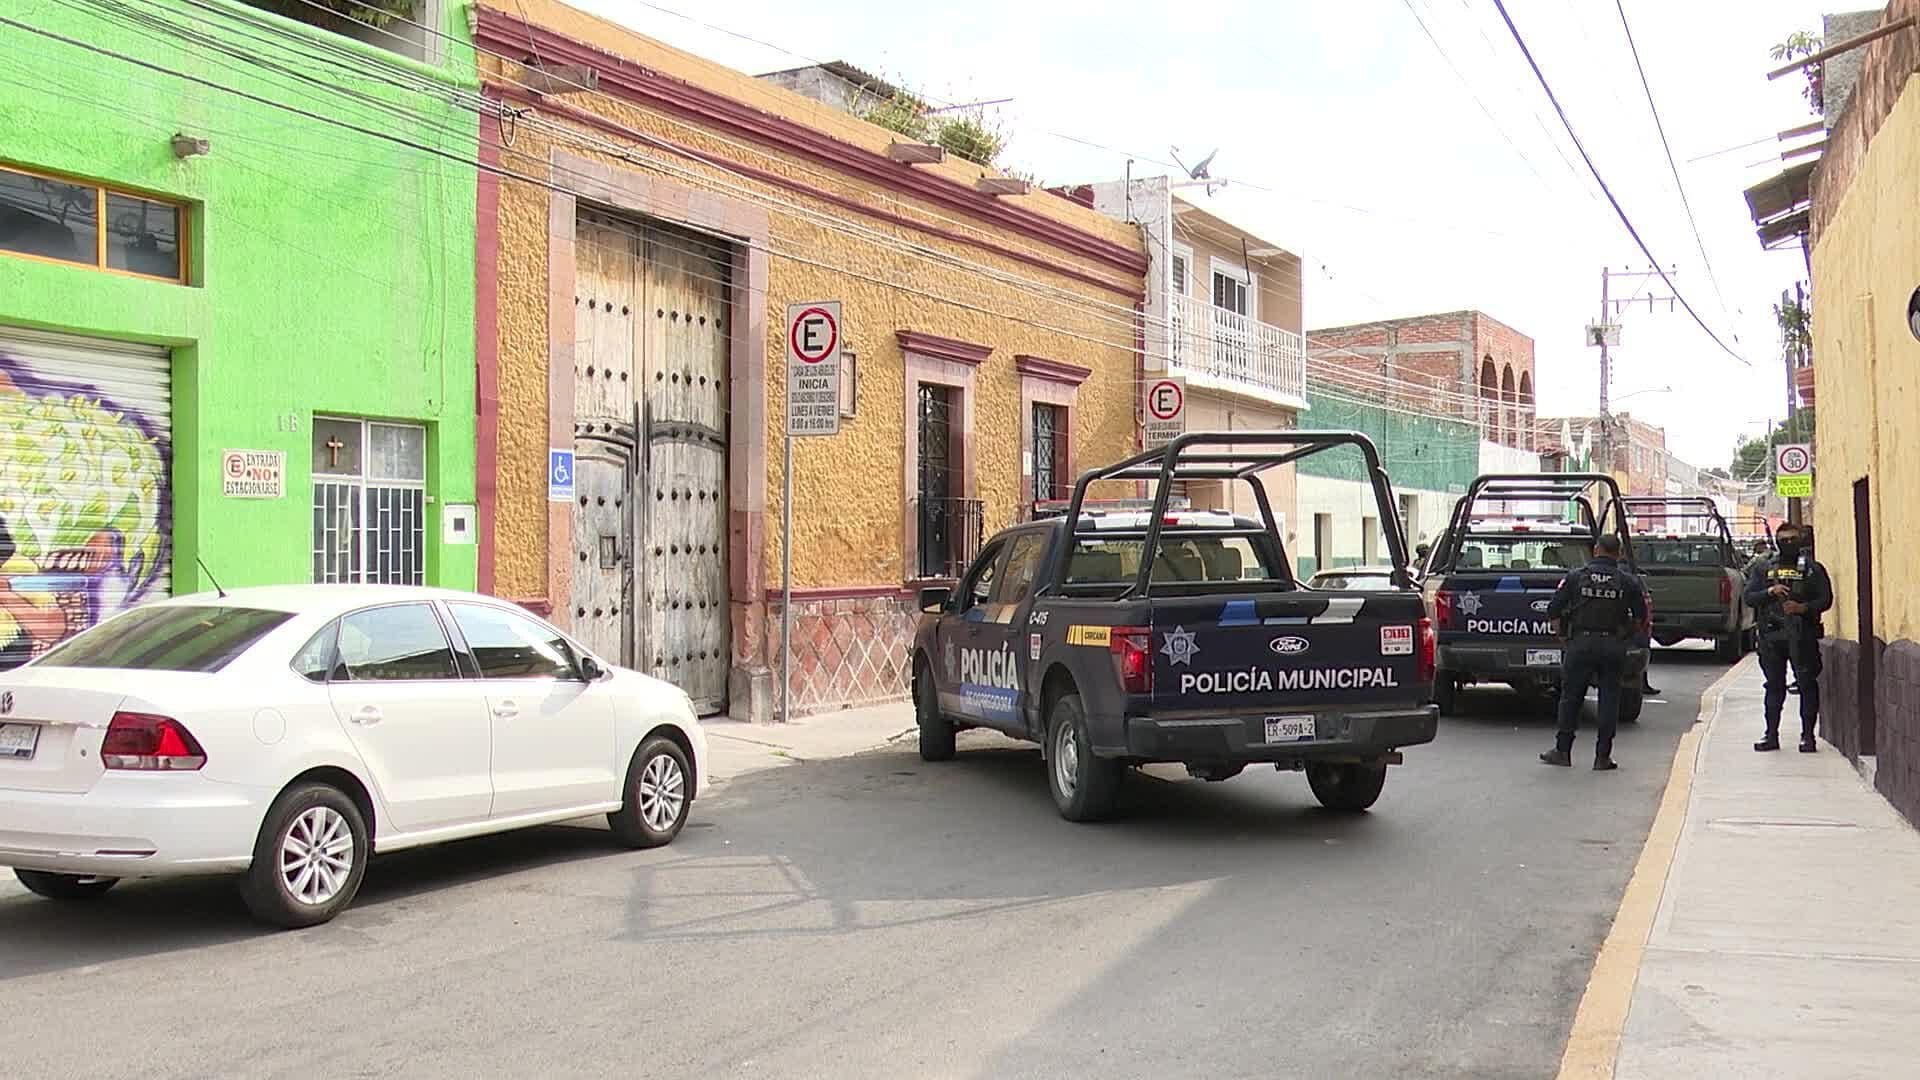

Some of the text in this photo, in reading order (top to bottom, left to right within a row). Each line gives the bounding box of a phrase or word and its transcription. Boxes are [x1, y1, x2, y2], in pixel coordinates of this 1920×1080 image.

[804, 319, 823, 351] E
[798, 378, 829, 389] INICIA
[1158, 389, 1173, 411] E
[791, 405, 808, 417] LUNES
[814, 404, 834, 416] VIERNES
[230, 459, 241, 473] E
[246, 454, 278, 467] ENTRADA
[1787, 458, 1802, 468] 30
[226, 481, 278, 495] ESTACIONARSE
[1029, 610, 1049, 625] C-415
[1467, 617, 1529, 634] POLICÍA
[1384, 628, 1409, 638] 911
[961, 640, 1019, 691] POLICÍA
[1181, 666, 1399, 694] POLICÍA MUNICIPAL
